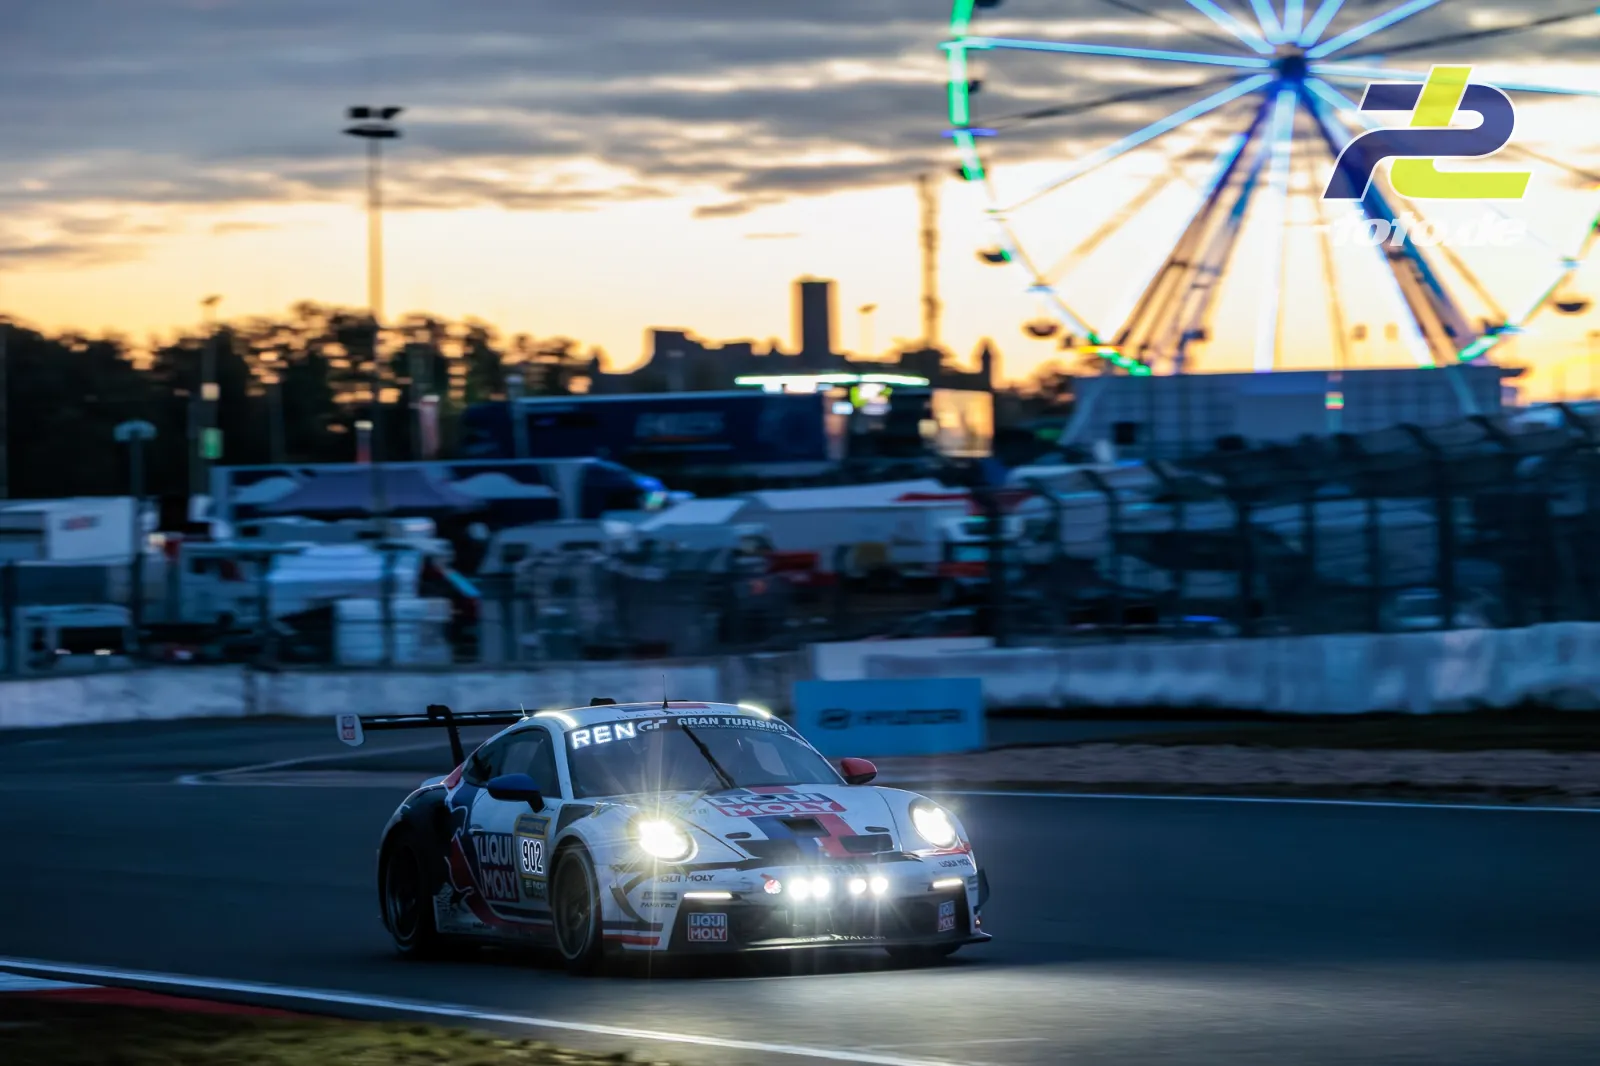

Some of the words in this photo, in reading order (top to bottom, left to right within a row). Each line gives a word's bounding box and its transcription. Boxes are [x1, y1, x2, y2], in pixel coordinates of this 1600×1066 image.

[677, 716, 719, 726] GRAN
[722, 716, 788, 733] TURISMO
[571, 722, 638, 750] REN
[709, 793, 825, 807] LIQUI
[720, 801, 834, 817] MOLY
[479, 834, 513, 867] LIQUI
[522, 839, 544, 875] 902
[482, 868, 516, 900] MOLY
[685, 873, 716, 882] MOLY
[690, 914, 725, 928] LIQUI
[690, 927, 725, 940] MOLY
